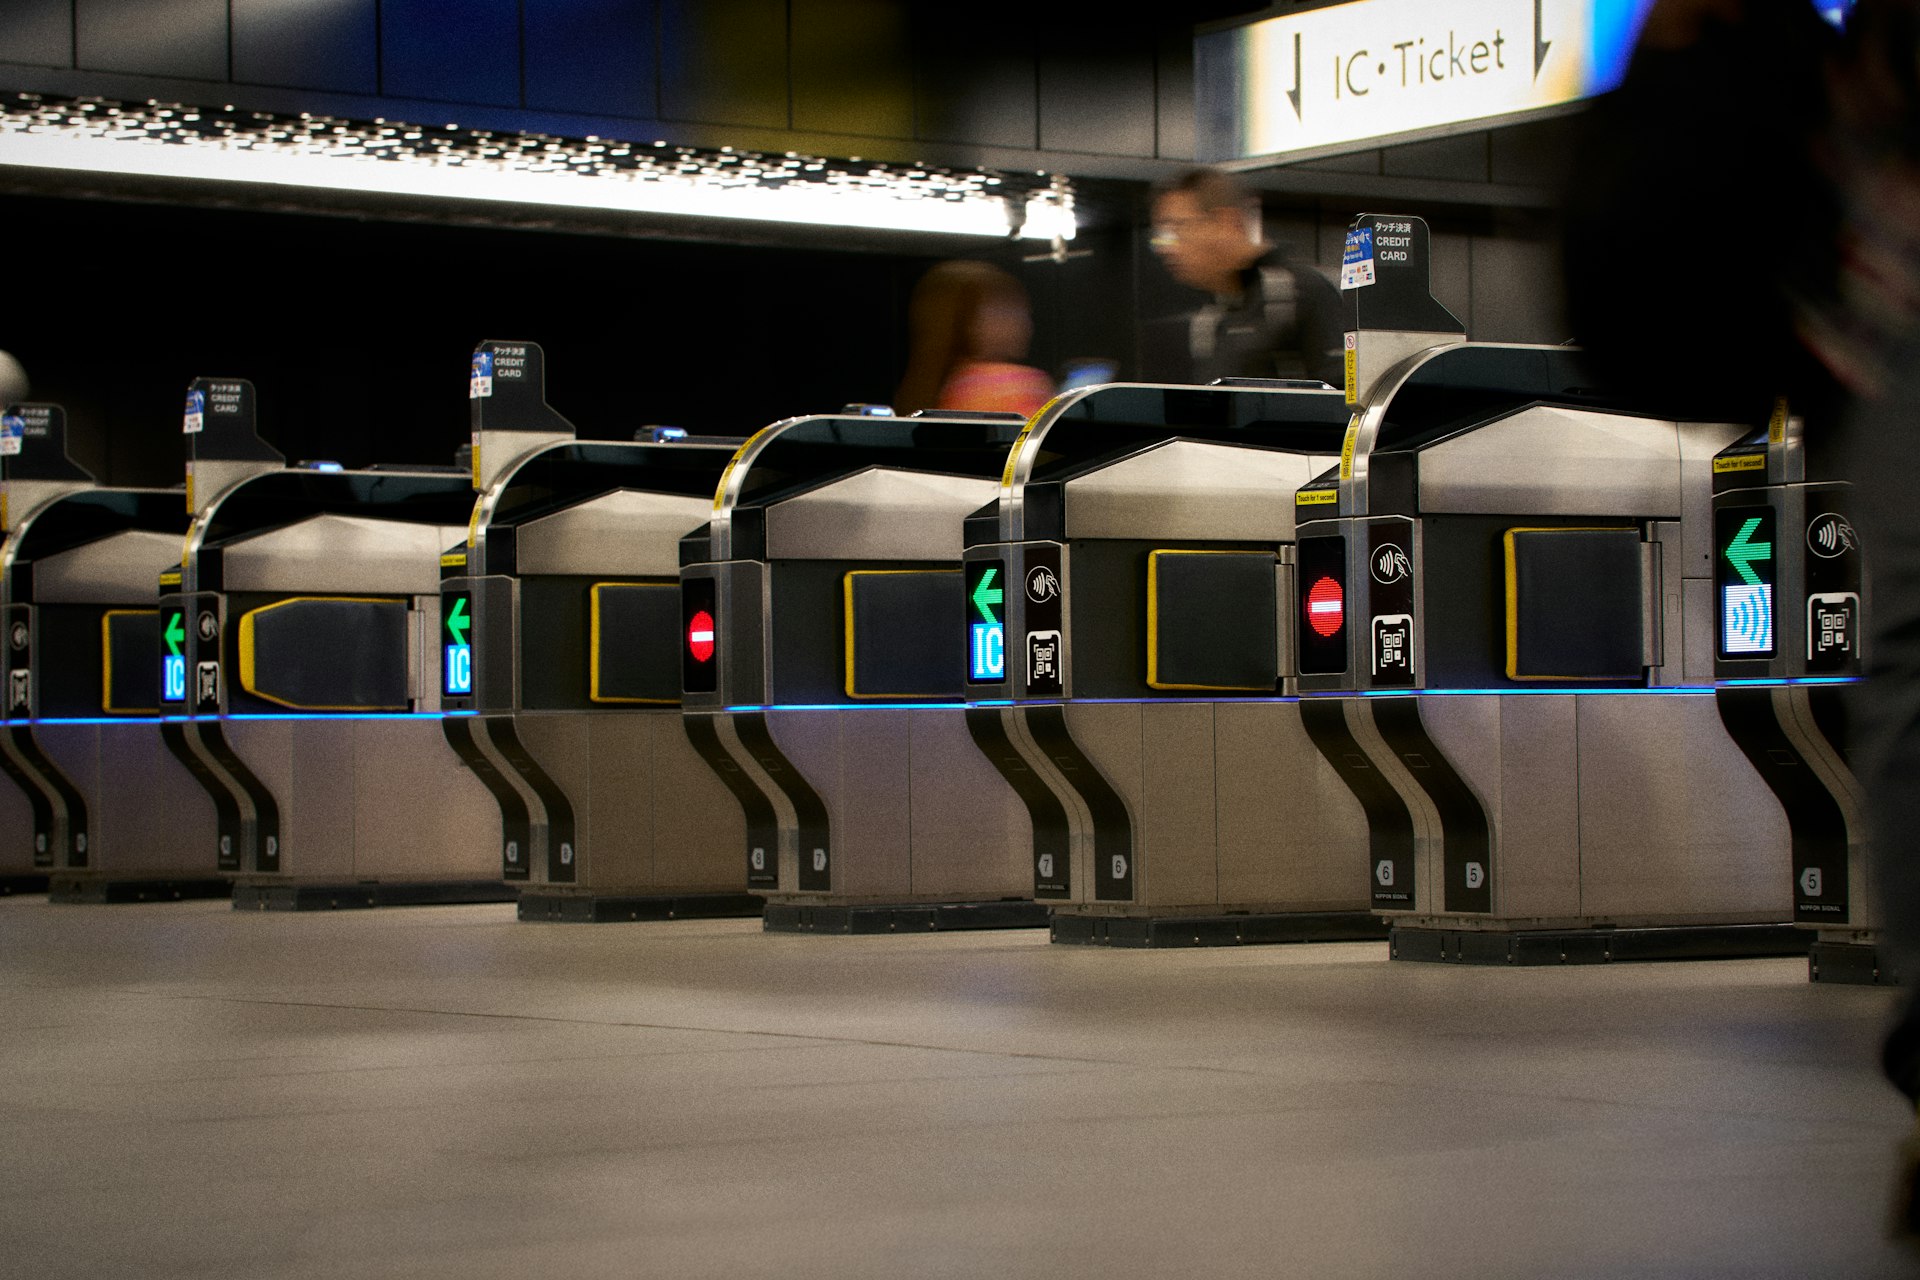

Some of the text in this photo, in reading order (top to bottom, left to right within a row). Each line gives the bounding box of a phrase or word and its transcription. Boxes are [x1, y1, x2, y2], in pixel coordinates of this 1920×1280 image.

[1375, 222, 1411, 233] タッチ決済
[1376, 237, 1410, 247] CREDIT
[1380, 251, 1407, 261] CARD
[494, 358, 525, 367] CREDIT
[498, 369, 522, 377] CARD
[211, 394, 240, 402] CREDIT
[214, 404, 238, 412] CARD
[1716, 461, 1730, 469] Touch
[975, 627, 1003, 675] IC
[449, 648, 470, 689] IC
[165, 659, 184, 697] IC
[816, 853, 821, 865] 7
[1043, 859, 1049, 872] 7
[1115, 860, 1122, 873] 6
[1382, 866, 1389, 880] 6
[1470, 868, 1478, 882] 5
[1808, 874, 1817, 889] 5
